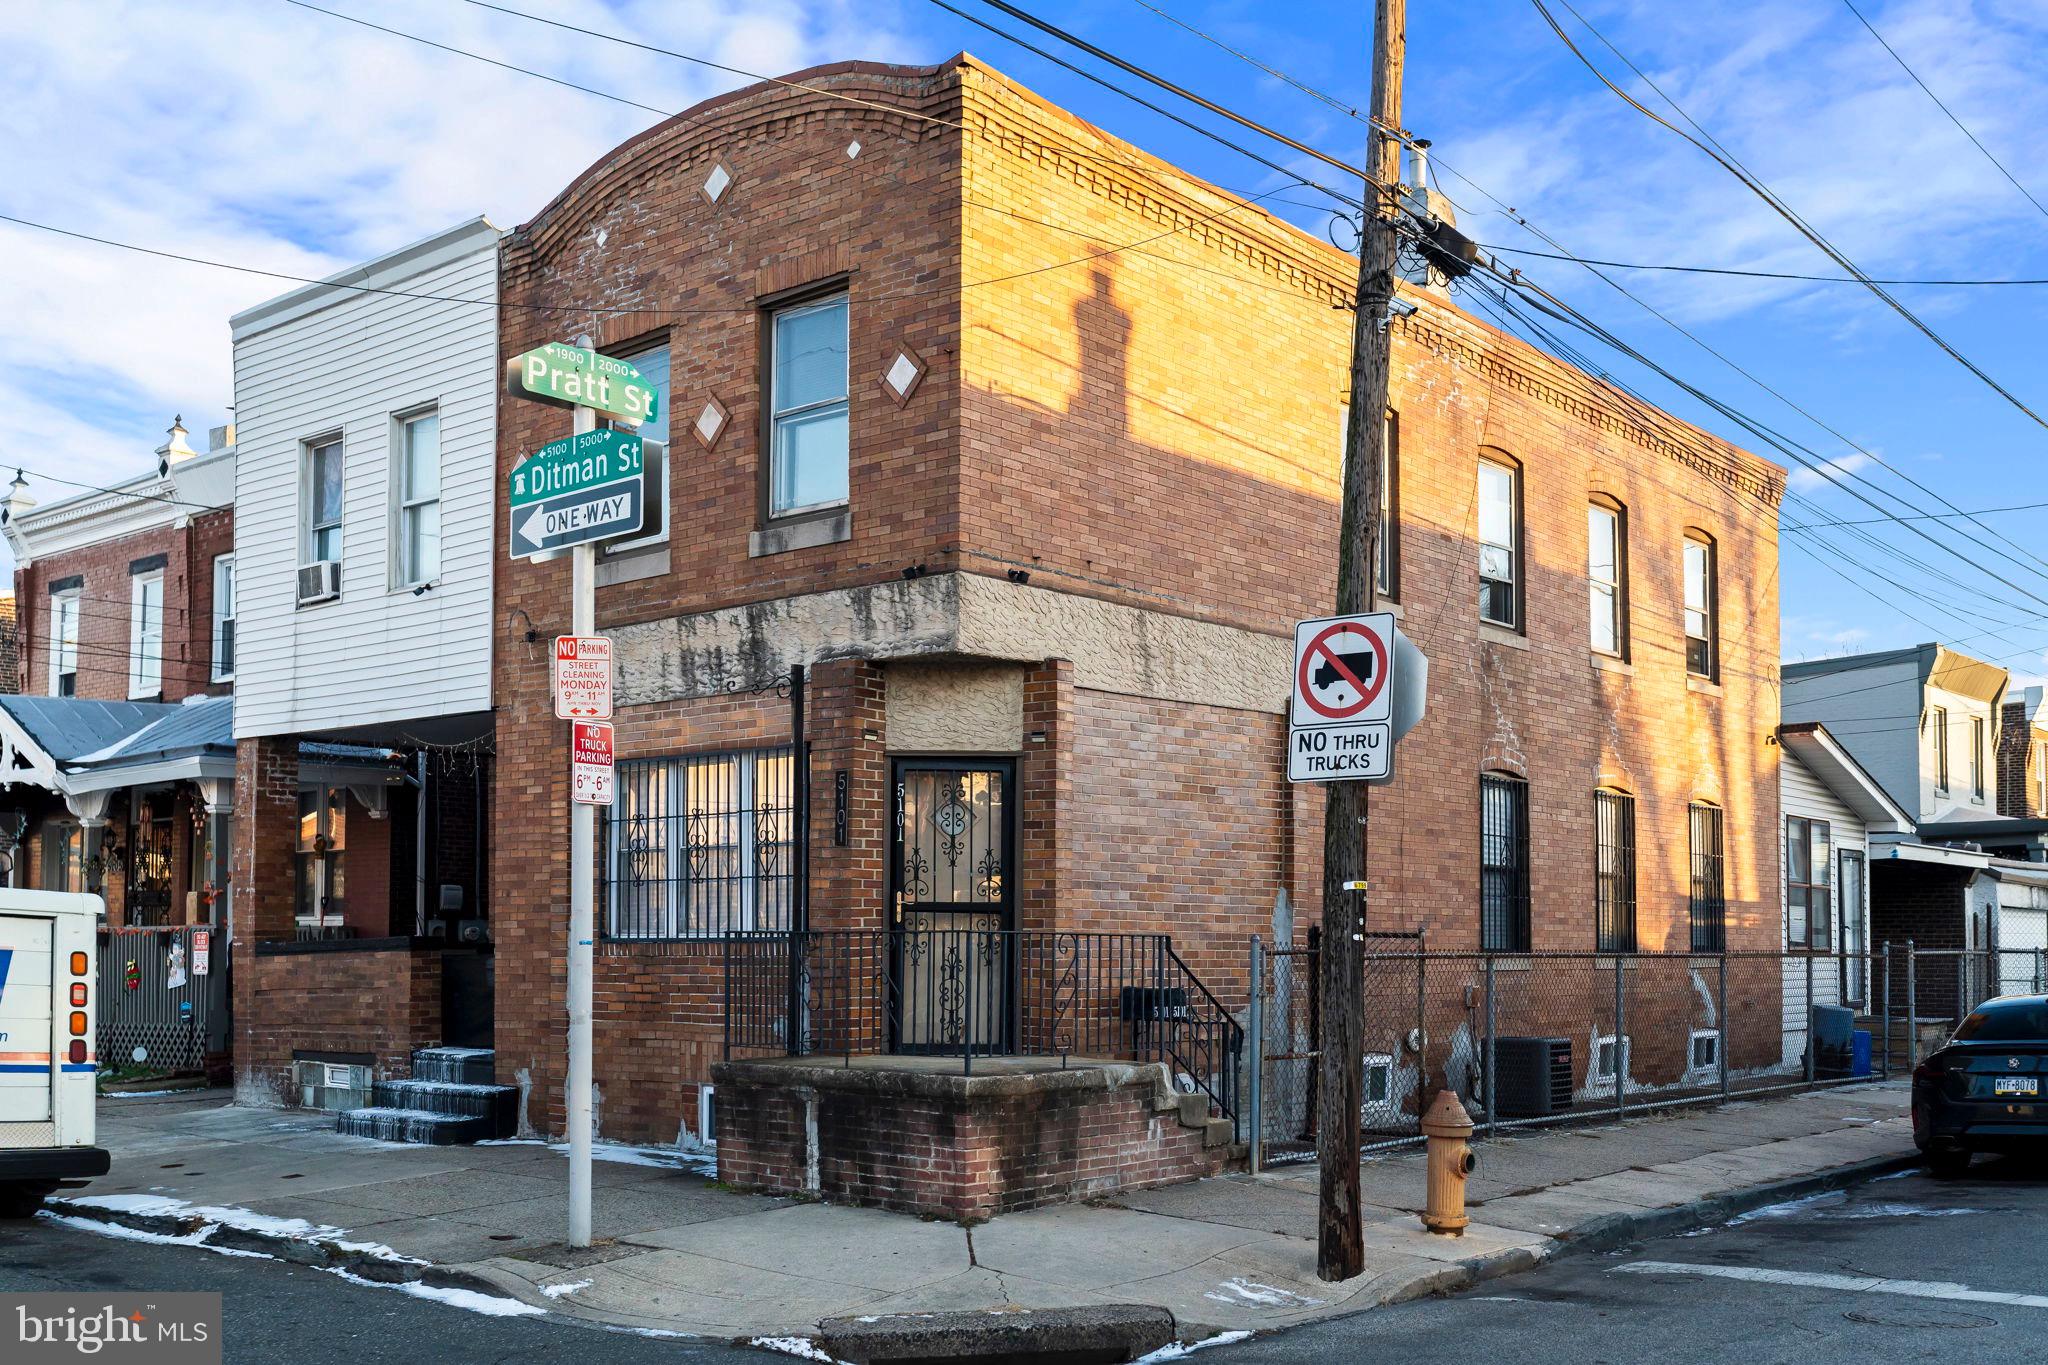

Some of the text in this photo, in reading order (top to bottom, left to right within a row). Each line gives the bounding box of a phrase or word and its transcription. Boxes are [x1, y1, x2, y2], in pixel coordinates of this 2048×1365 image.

[557, 347, 629, 377] 1900 2000
[528, 356, 653, 417] Pratt St
[547, 432, 603, 457] 5100 5000
[532, 442, 640, 495] Ditman St
[546, 496, 624, 533] ONE WAY
[559, 641, 608, 657] NO PARKING
[562, 671, 605, 679] CLEANING
[568, 662, 599, 670] STREET
[560, 680, 607, 690] MONDAY
[586, 727, 600, 738] NO
[1299, 732, 1379, 752] NO THRU
[580, 738, 607, 751] TRUCK
[575, 751, 611, 764] PARKING
[1306, 753, 1370, 772] TRUCKS
[837, 773, 846, 842] 5101
[897, 783, 905, 842] 5101
